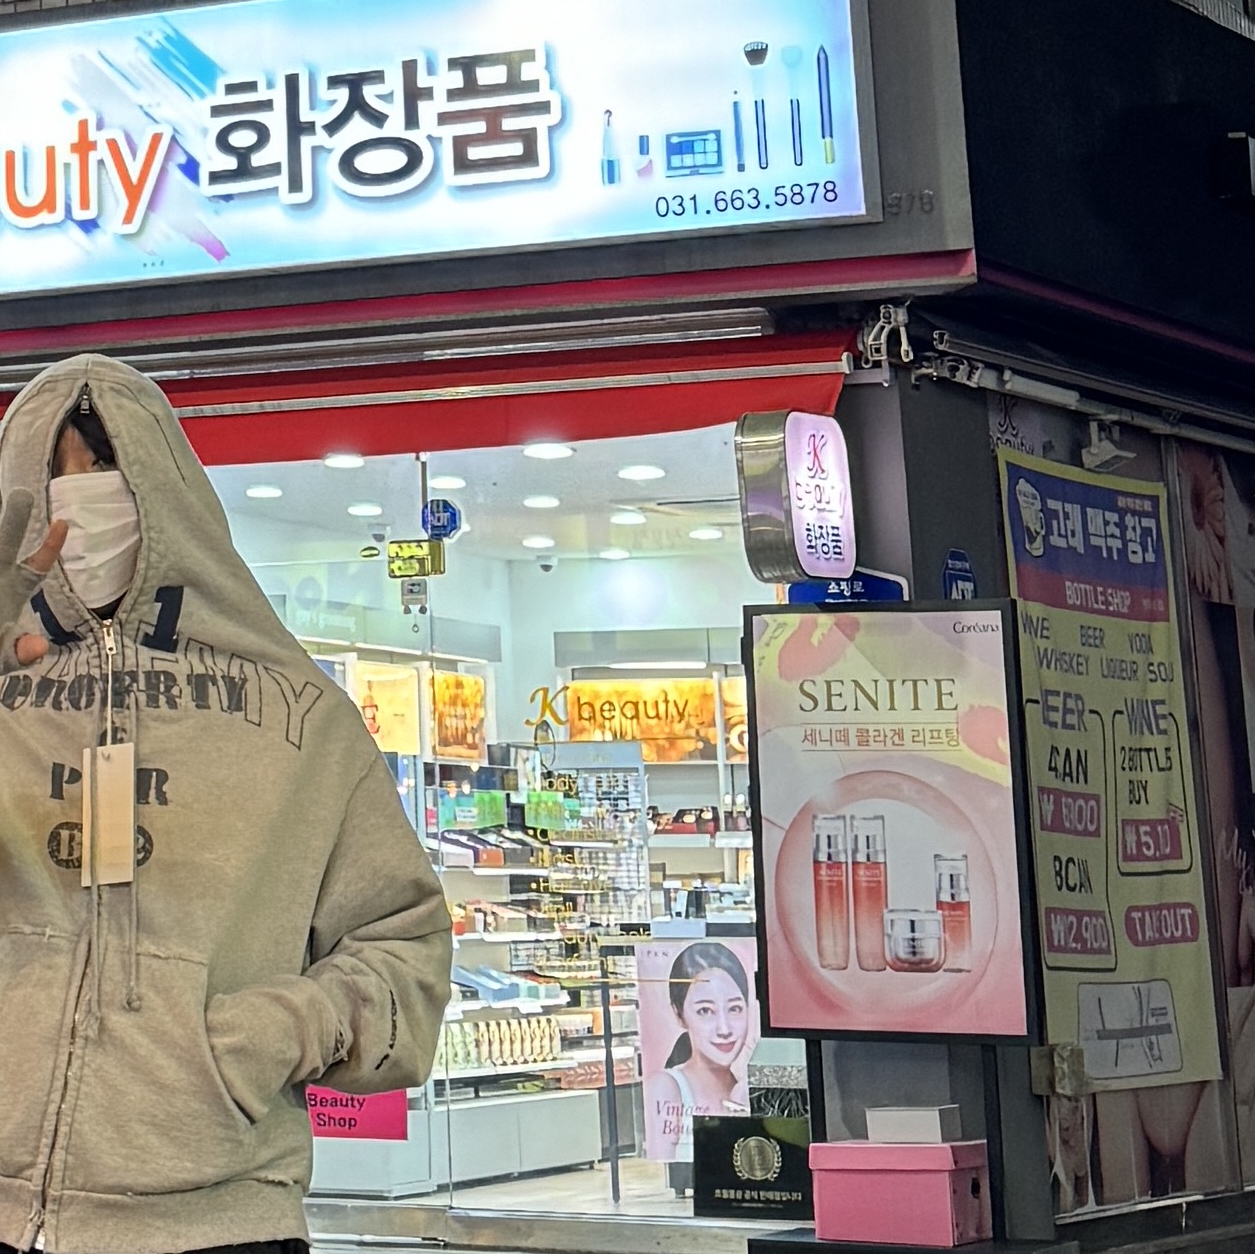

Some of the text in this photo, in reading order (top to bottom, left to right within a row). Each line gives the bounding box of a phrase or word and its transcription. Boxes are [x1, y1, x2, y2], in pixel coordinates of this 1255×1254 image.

[206, 48, 551, 196] 화장품
[655, 180, 840, 218] 031.663.5878
[806, 433, 829, 477] K
[805, 522, 844, 560] 화장품
[1046, 499, 1085, 554] 고래
[1124, 512, 1157, 564] 창고
[1065, 580, 1106, 610] BOTTLE
[1108, 588, 1131, 613] SHOP
[524, 685, 689, 727] K beauty
[798, 678, 959, 713] SENITE
[802, 727, 960, 747] 세니떼 콜라겐 리프팅
[307, 1092, 366, 1112] Beauty
[316, 1112, 358, 1130] Shop
